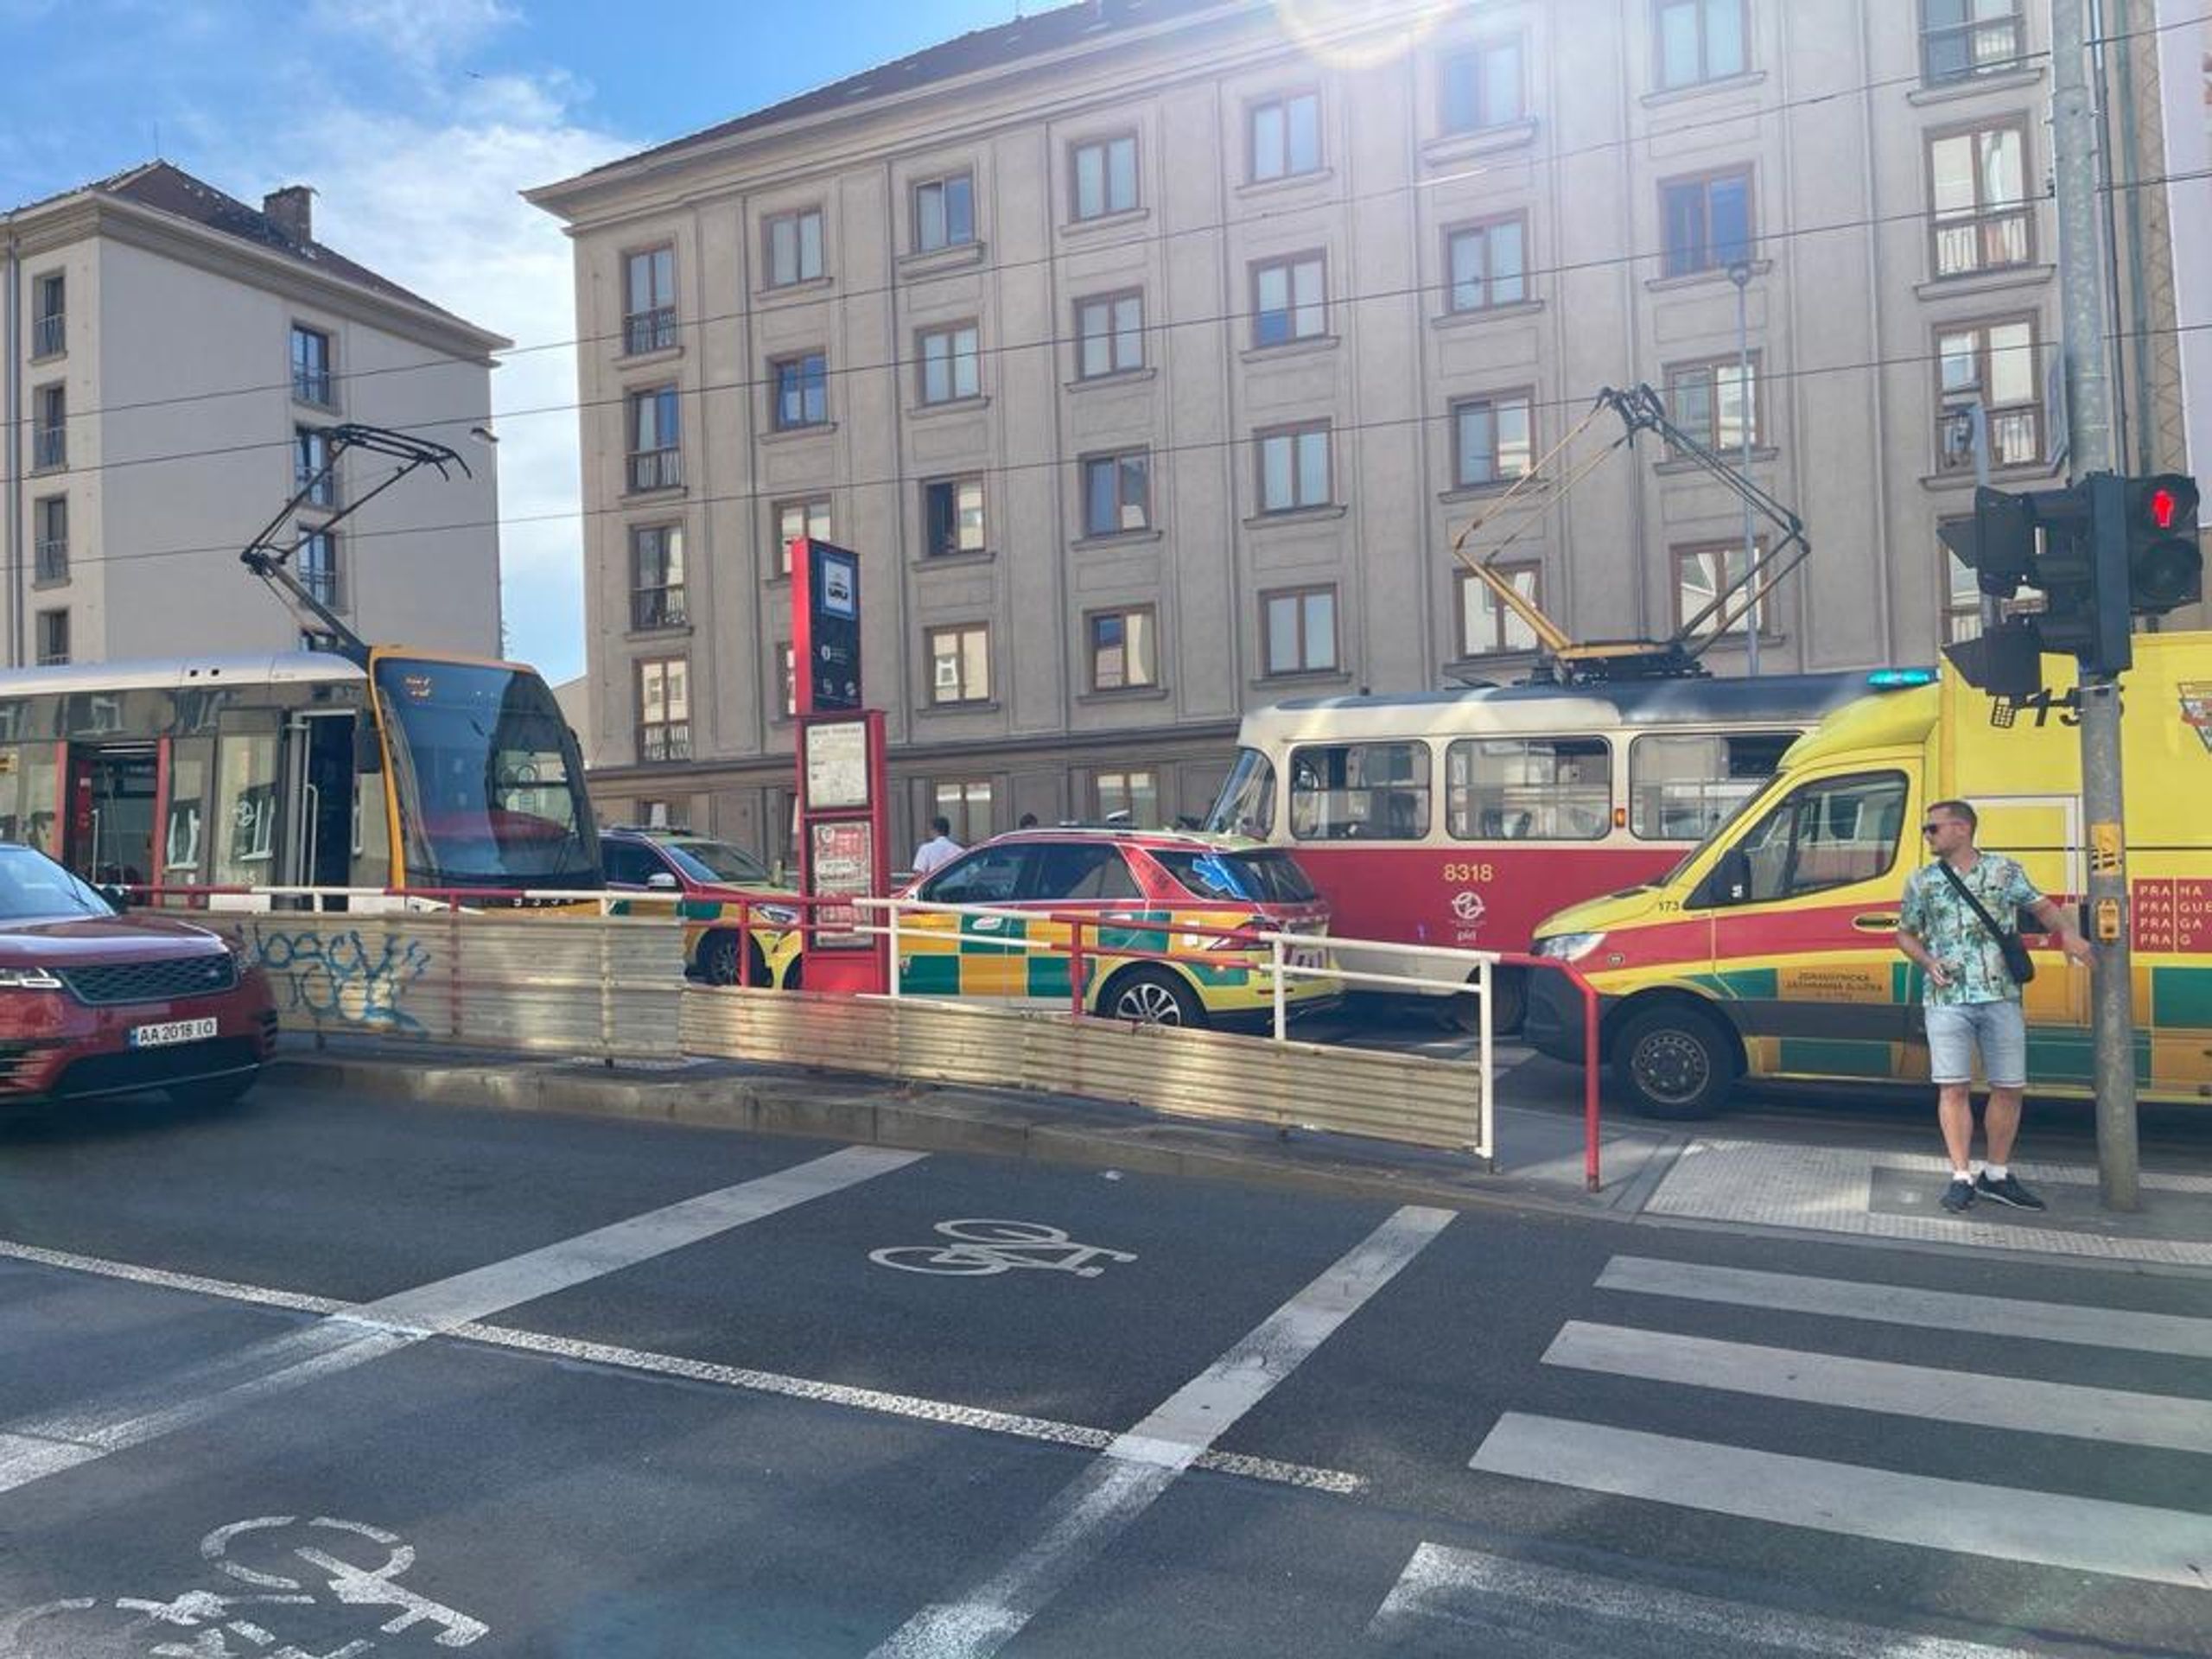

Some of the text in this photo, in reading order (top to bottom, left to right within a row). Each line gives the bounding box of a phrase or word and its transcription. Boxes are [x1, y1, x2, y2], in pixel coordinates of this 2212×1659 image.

[1444, 863, 1492, 882] 8318
[2139, 886, 2171, 897] PRA
[2139, 902, 2171, 913] PRA
[2139, 918, 2171, 929] PRA
[2139, 933, 2171, 945] PRA
